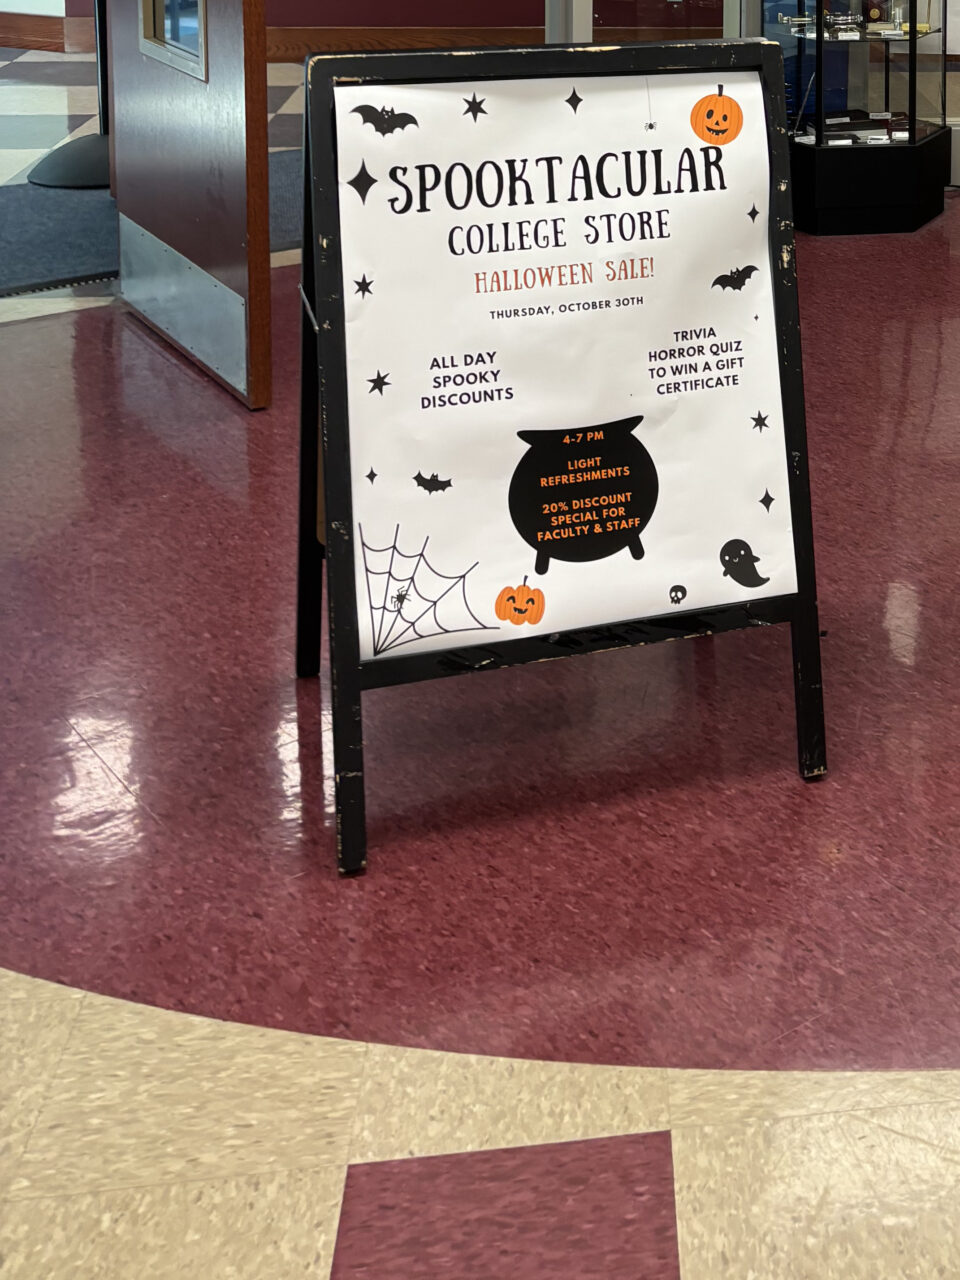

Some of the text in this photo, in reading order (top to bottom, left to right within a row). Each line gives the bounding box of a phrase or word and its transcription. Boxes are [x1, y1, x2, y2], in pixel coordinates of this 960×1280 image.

[387, 145, 727, 215] SPOOKTACULAR
[448, 209, 671, 256] COLLEGE STORE
[474, 257, 655, 294] HALLOWEEN SALE!
[489, 296, 644, 320] THURSDAY, OCTOBER 30TH
[673, 326, 717, 343] TRIVIA
[429, 351, 497, 371] ALL DAY
[648, 340, 743, 363] HORROR QUIZ
[432, 369, 501, 389] SPOOKY
[648, 356, 745, 380] TO WIN A GIFT
[656, 374, 740, 396] CERTIFICATE
[420, 387, 515, 410] DISCOUNTS
[562, 430, 605, 445] 4-7 PM
[567, 456, 602, 471] LIGHT
[540, 466, 631, 488] REFRESHMENTS
[542, 492, 633, 515] 20% DISCOUNT
[550, 506, 626, 527] SPECIAL FOR
[537, 517, 641, 542] FACULTY & STAFF
